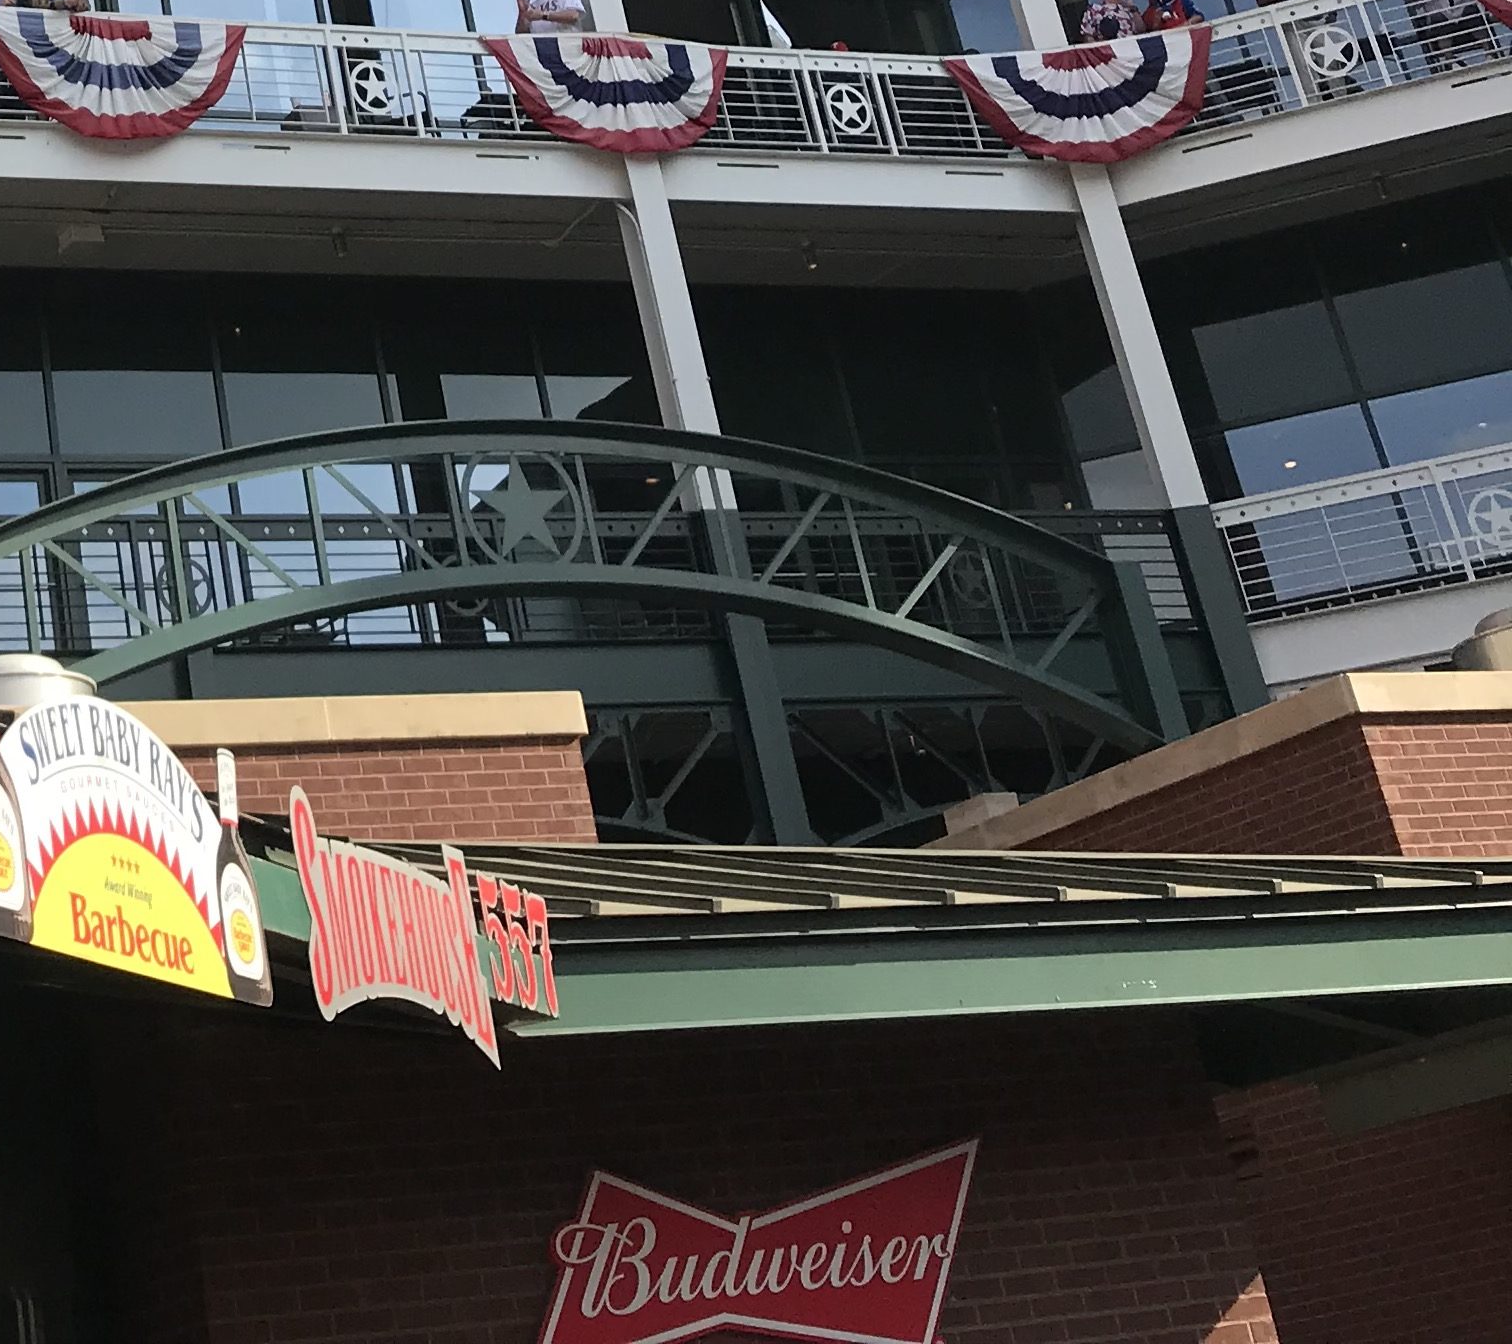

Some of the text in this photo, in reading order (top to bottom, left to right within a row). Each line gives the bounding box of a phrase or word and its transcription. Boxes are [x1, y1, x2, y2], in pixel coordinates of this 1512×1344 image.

[19, 702, 203, 844] SWEET BABY RAY'S
[68, 891, 195, 974] Barbecue
[292, 796, 560, 1052] SMOKEHOUSE 557
[555, 1215, 951, 1318] Budweiser
